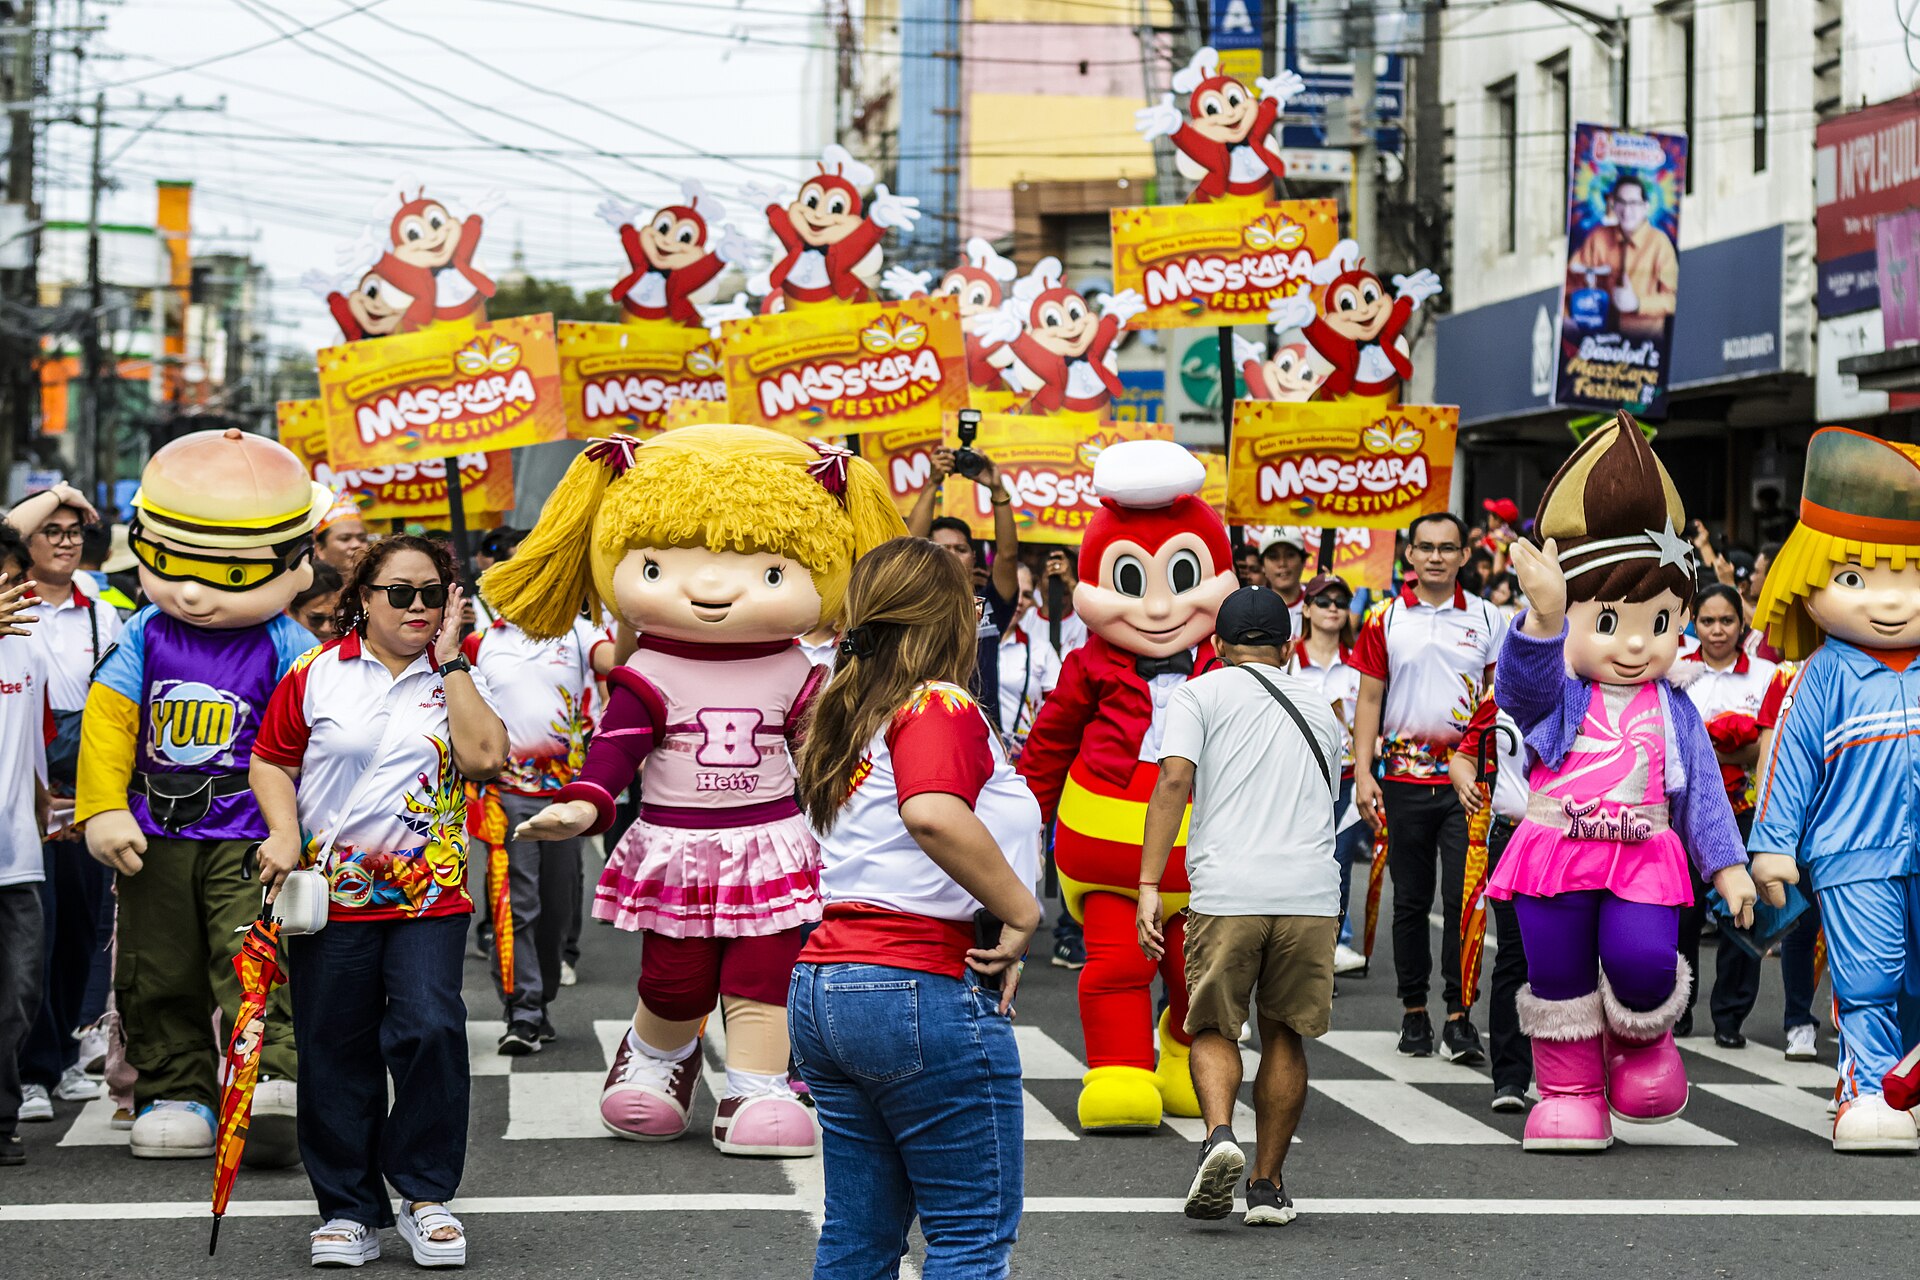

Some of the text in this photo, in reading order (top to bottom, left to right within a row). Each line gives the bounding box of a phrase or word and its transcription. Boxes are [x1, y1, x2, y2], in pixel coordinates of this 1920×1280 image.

[1145, 250, 1314, 305] MASSKARA
[585, 376, 727, 419] MASSKAR
[759, 349, 942, 417] MASSKARA
[831, 379, 938, 416] FESTIVAL
[357, 369, 537, 444] MASSKARA
[428, 400, 532, 440] FESTIVAL
[1260, 441, 1277, 452] Join
[1279, 437, 1294, 446] the
[1260, 455, 1428, 502] MASSKARA
[1322, 484, 1423, 511] FESTIVAL
[1042, 506, 1095, 528] FEST
[151, 700, 234, 748] YUM
[696, 772, 759, 793] Hetty
